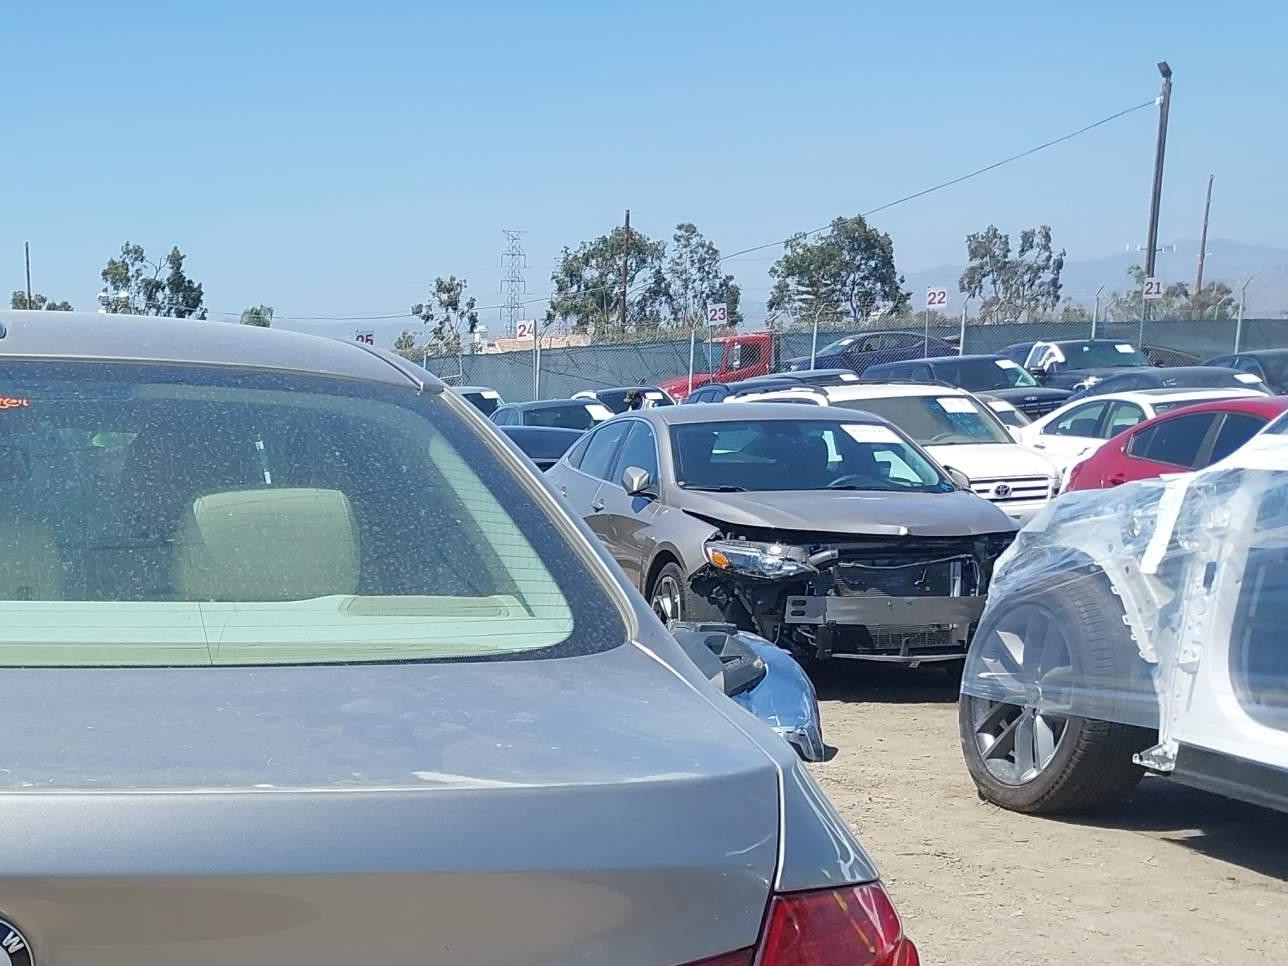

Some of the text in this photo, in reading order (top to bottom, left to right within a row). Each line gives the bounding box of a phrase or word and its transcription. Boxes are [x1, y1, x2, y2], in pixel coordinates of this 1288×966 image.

[1144, 281, 1162, 295] 21
[927, 291, 946, 305] 22
[709, 307, 726, 321] 23
